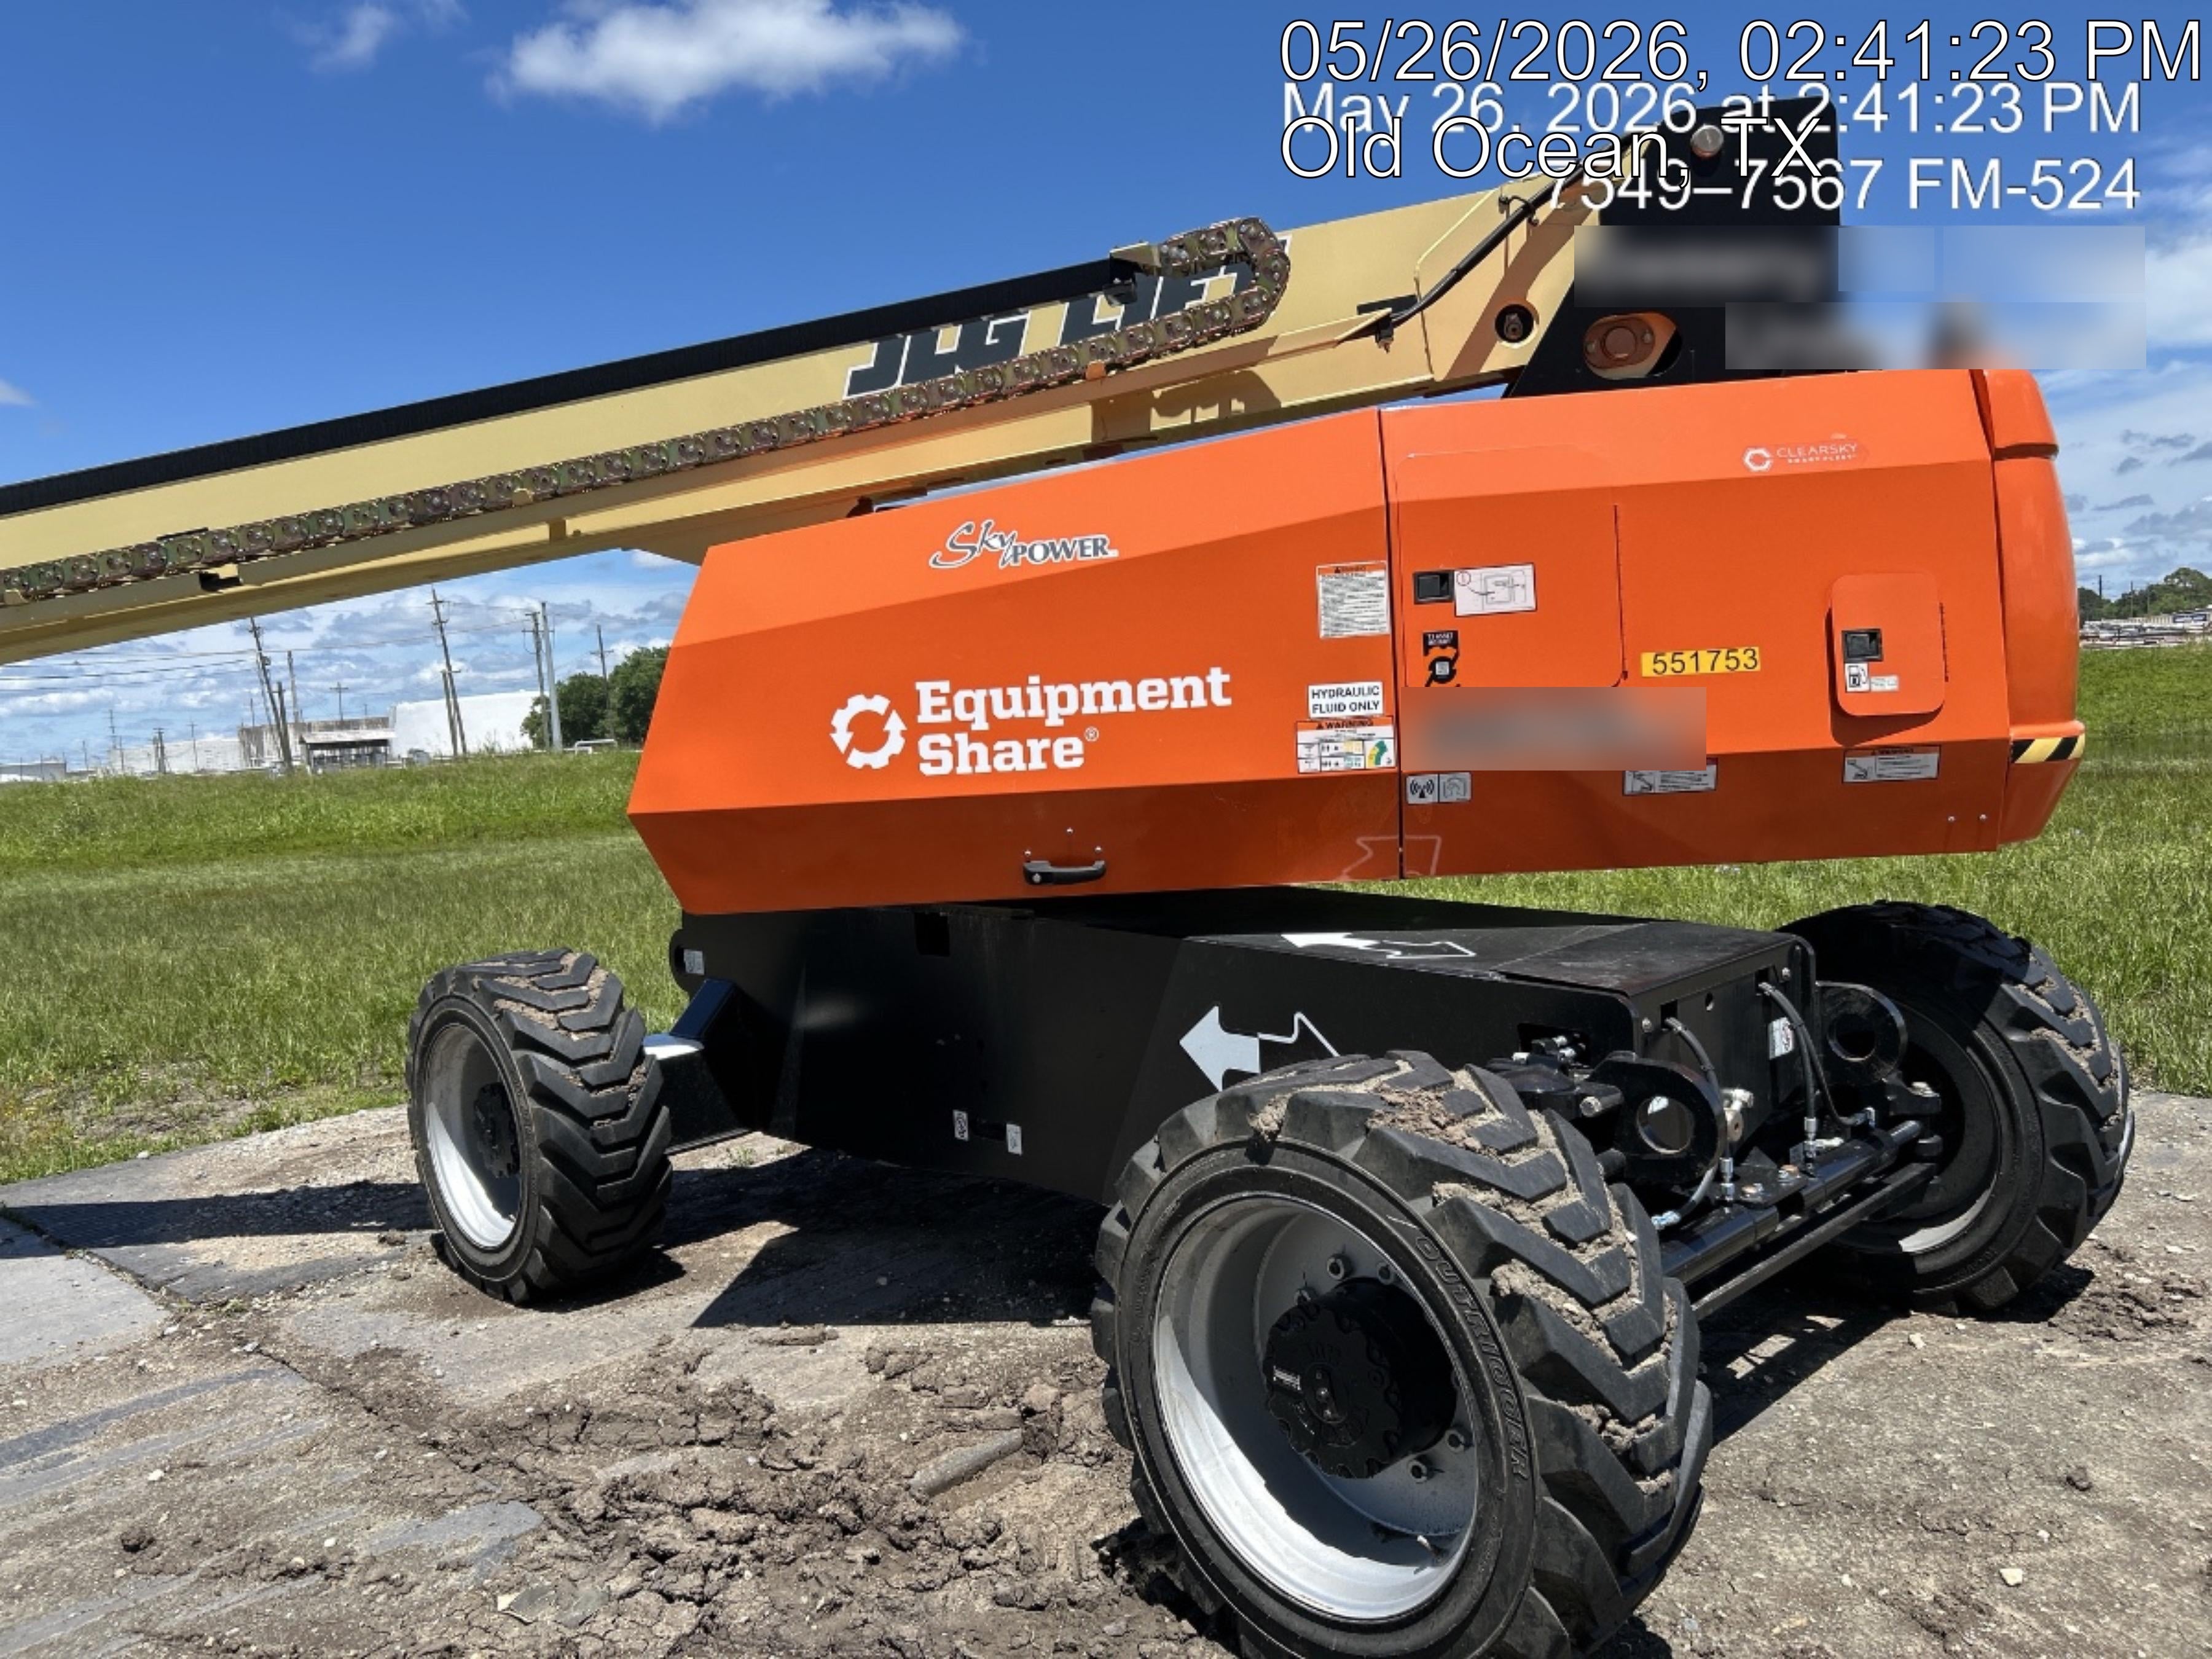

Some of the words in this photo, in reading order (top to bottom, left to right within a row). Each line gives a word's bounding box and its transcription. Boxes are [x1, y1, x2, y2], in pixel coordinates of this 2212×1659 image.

[1776, 443, 1858, 458] CLEARSKY
[1652, 648, 1758, 675] 551753
[916, 667, 1233, 731] Equipment
[1311, 685, 1380, 699] HYDRAULIC
[1312, 702, 1346, 714] FLUID
[1349, 700, 1380, 712] ONLY
